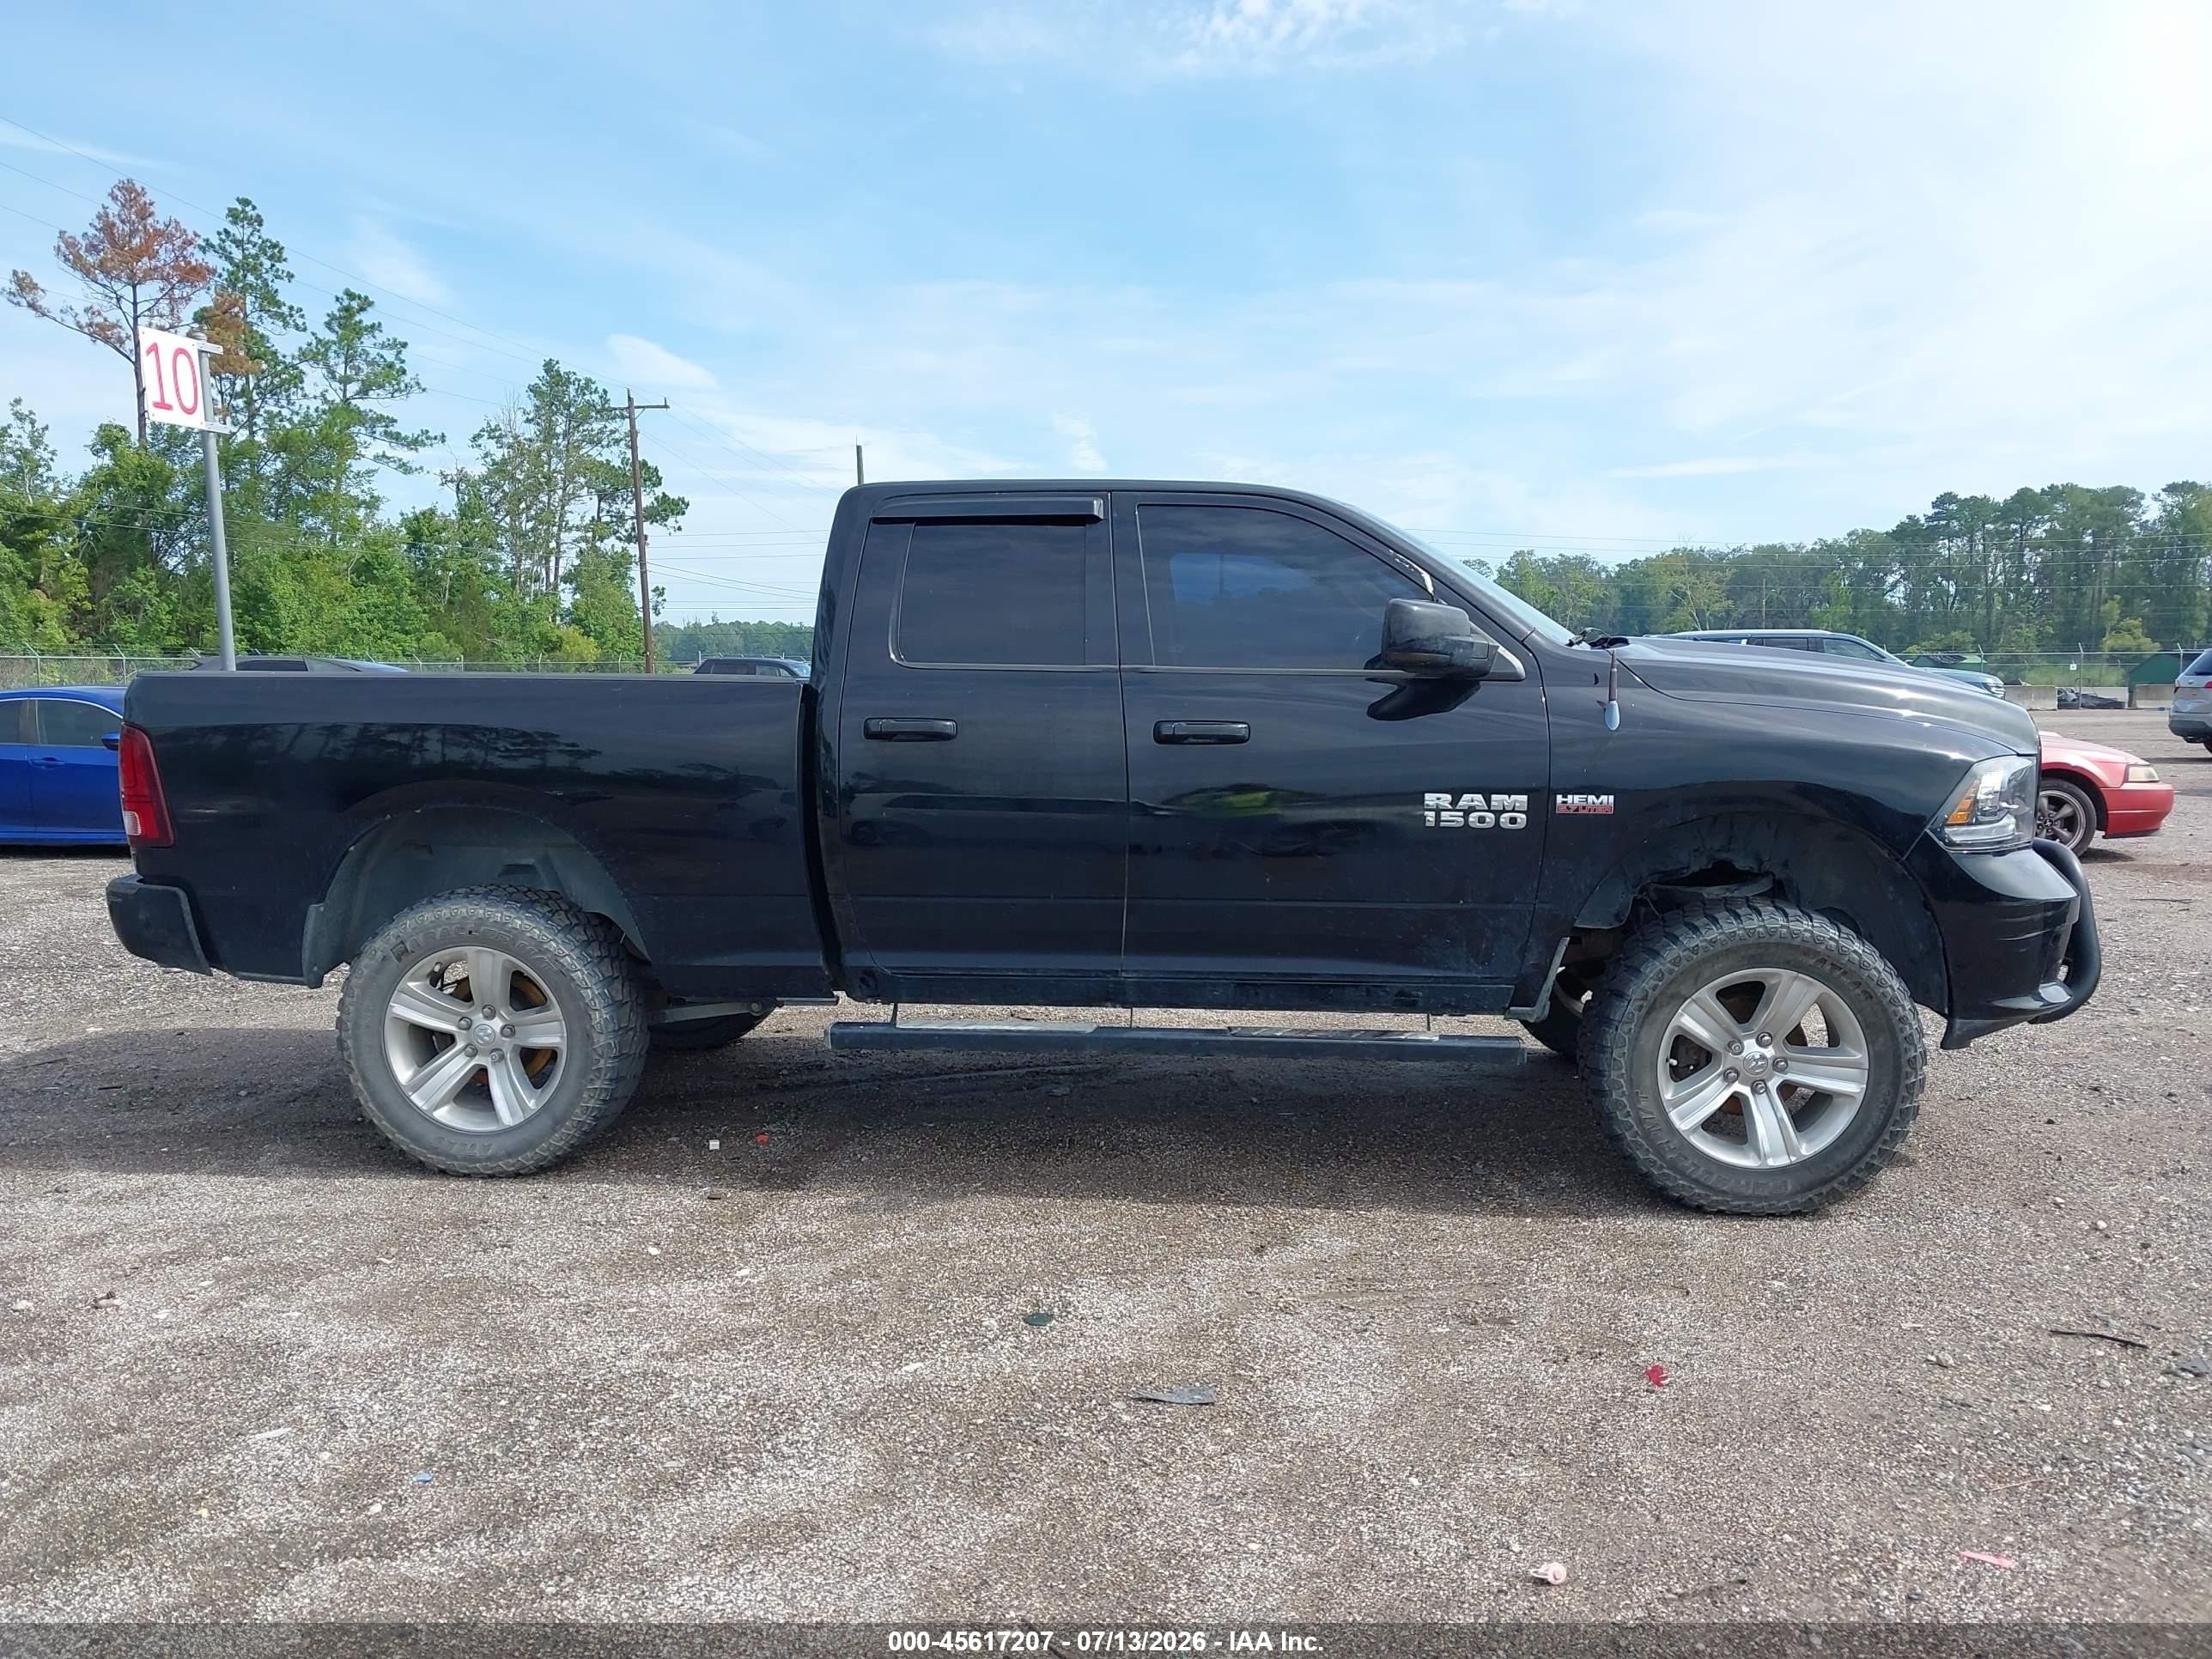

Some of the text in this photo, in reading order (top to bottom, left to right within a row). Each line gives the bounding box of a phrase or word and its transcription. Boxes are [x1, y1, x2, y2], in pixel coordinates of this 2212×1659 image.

[145, 342, 198, 415] 10
[1424, 793, 1528, 811] RAM
[1556, 794, 1614, 805] HEMI
[1424, 811, 1528, 829] 1500
